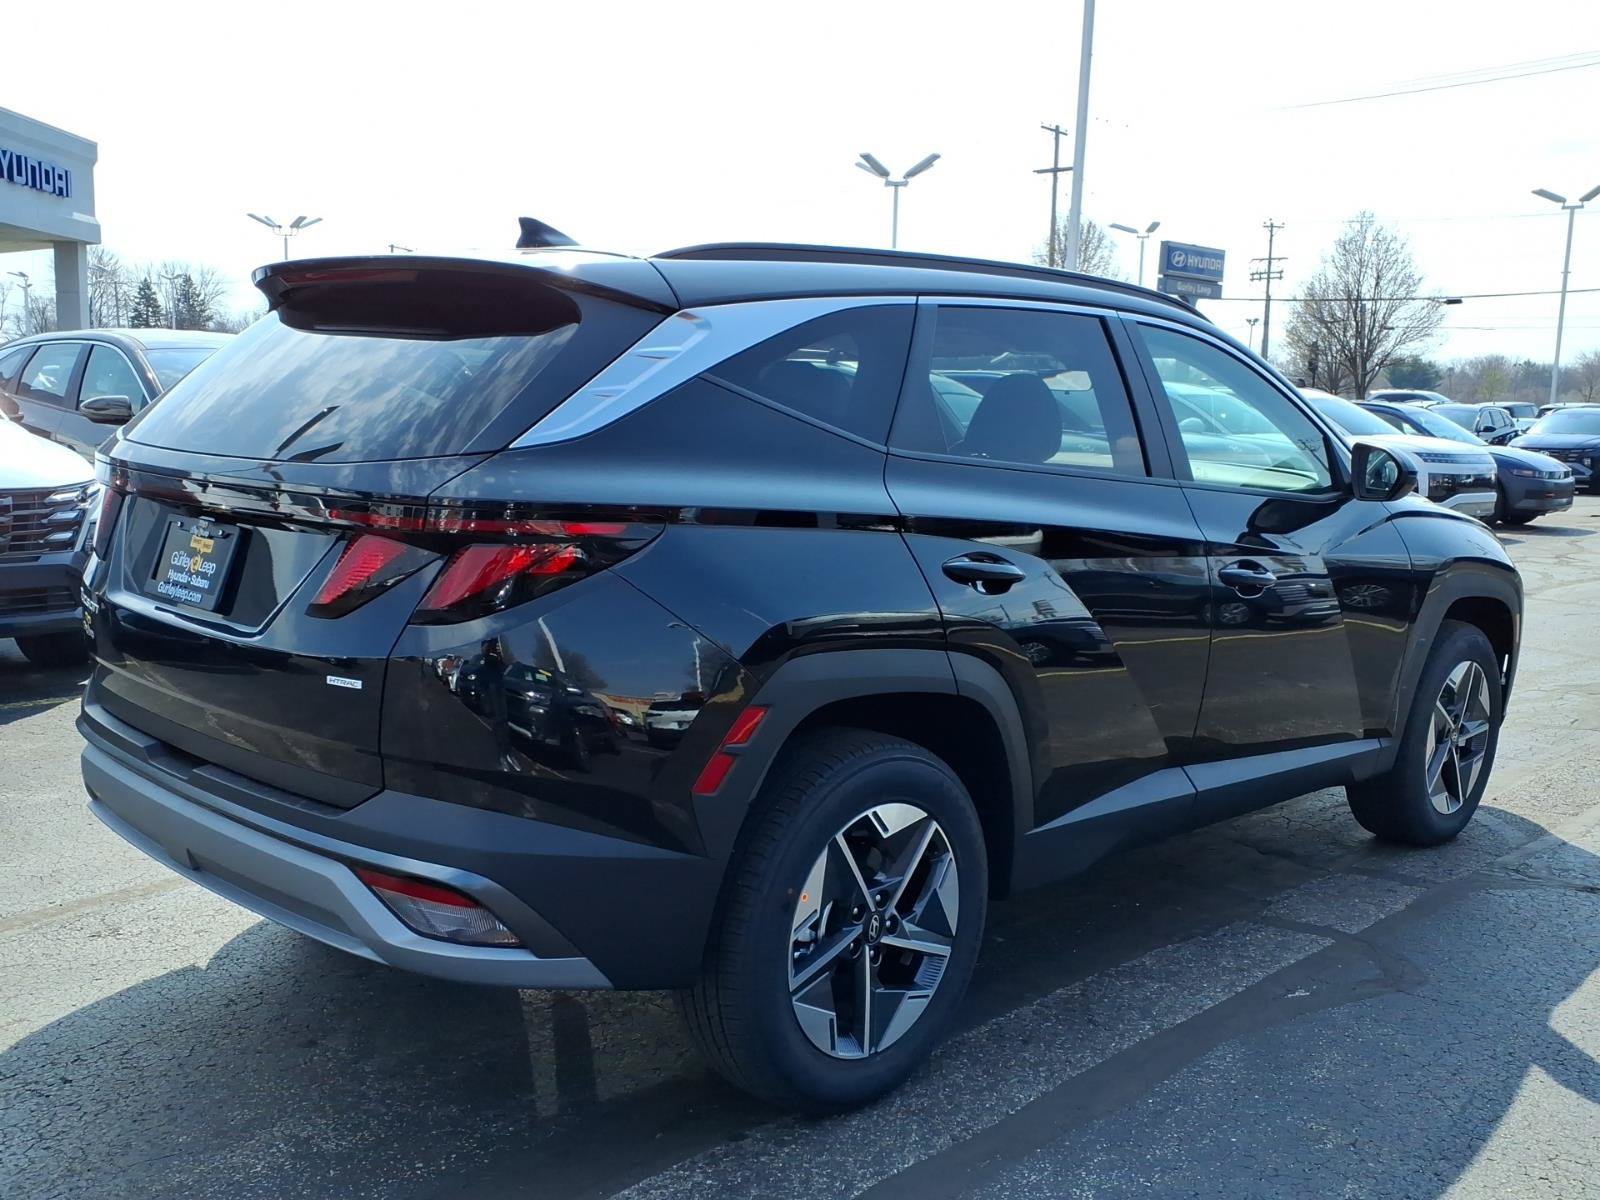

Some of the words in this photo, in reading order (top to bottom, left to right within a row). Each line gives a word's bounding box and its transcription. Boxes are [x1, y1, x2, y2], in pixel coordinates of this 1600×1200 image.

[198, 558, 216, 577] Leep
[190, 574, 210, 589] Subaru
[329, 677, 360, 687] HTRAC
